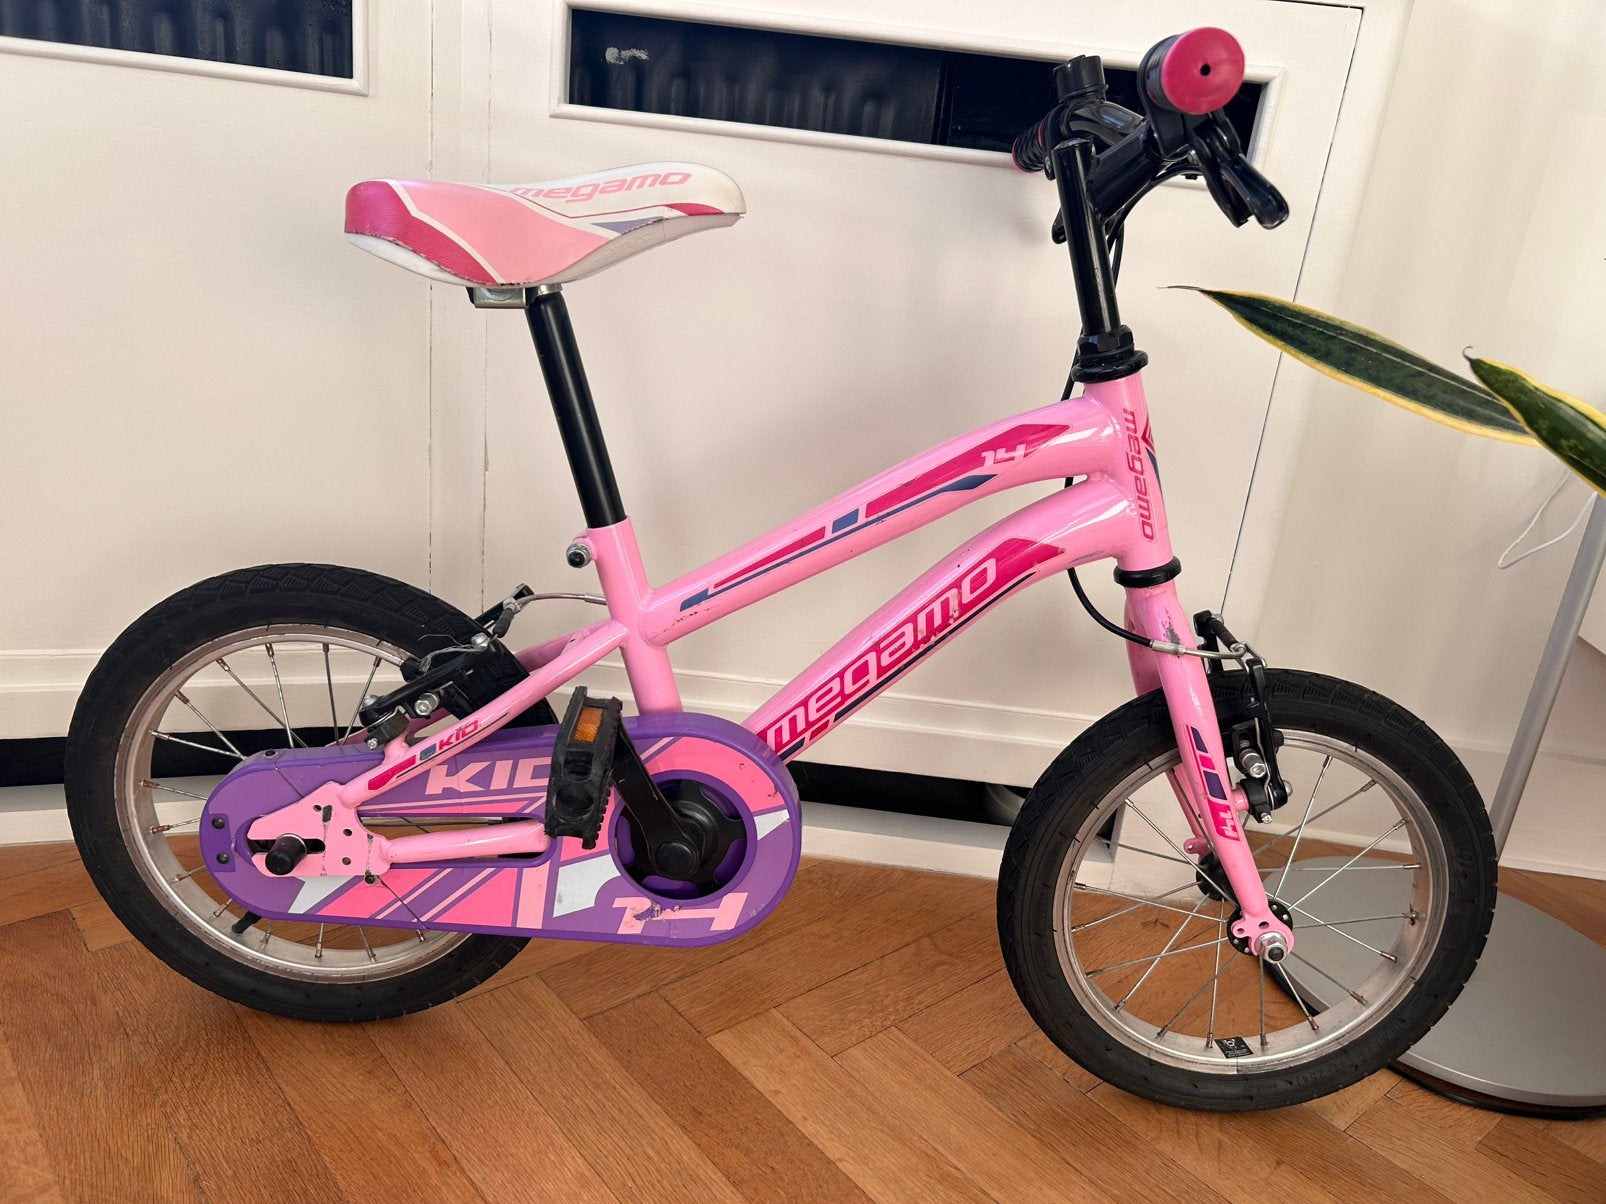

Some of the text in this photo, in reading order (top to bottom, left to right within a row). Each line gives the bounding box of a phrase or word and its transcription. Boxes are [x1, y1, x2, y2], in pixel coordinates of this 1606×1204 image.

[508, 172, 692, 203] megamo
[981, 443, 1027, 466] 14
[1113, 408, 1155, 541] megamo
[766, 557, 997, 752] megamo
[438, 719, 482, 751] KID
[1219, 809, 1238, 838] 14
